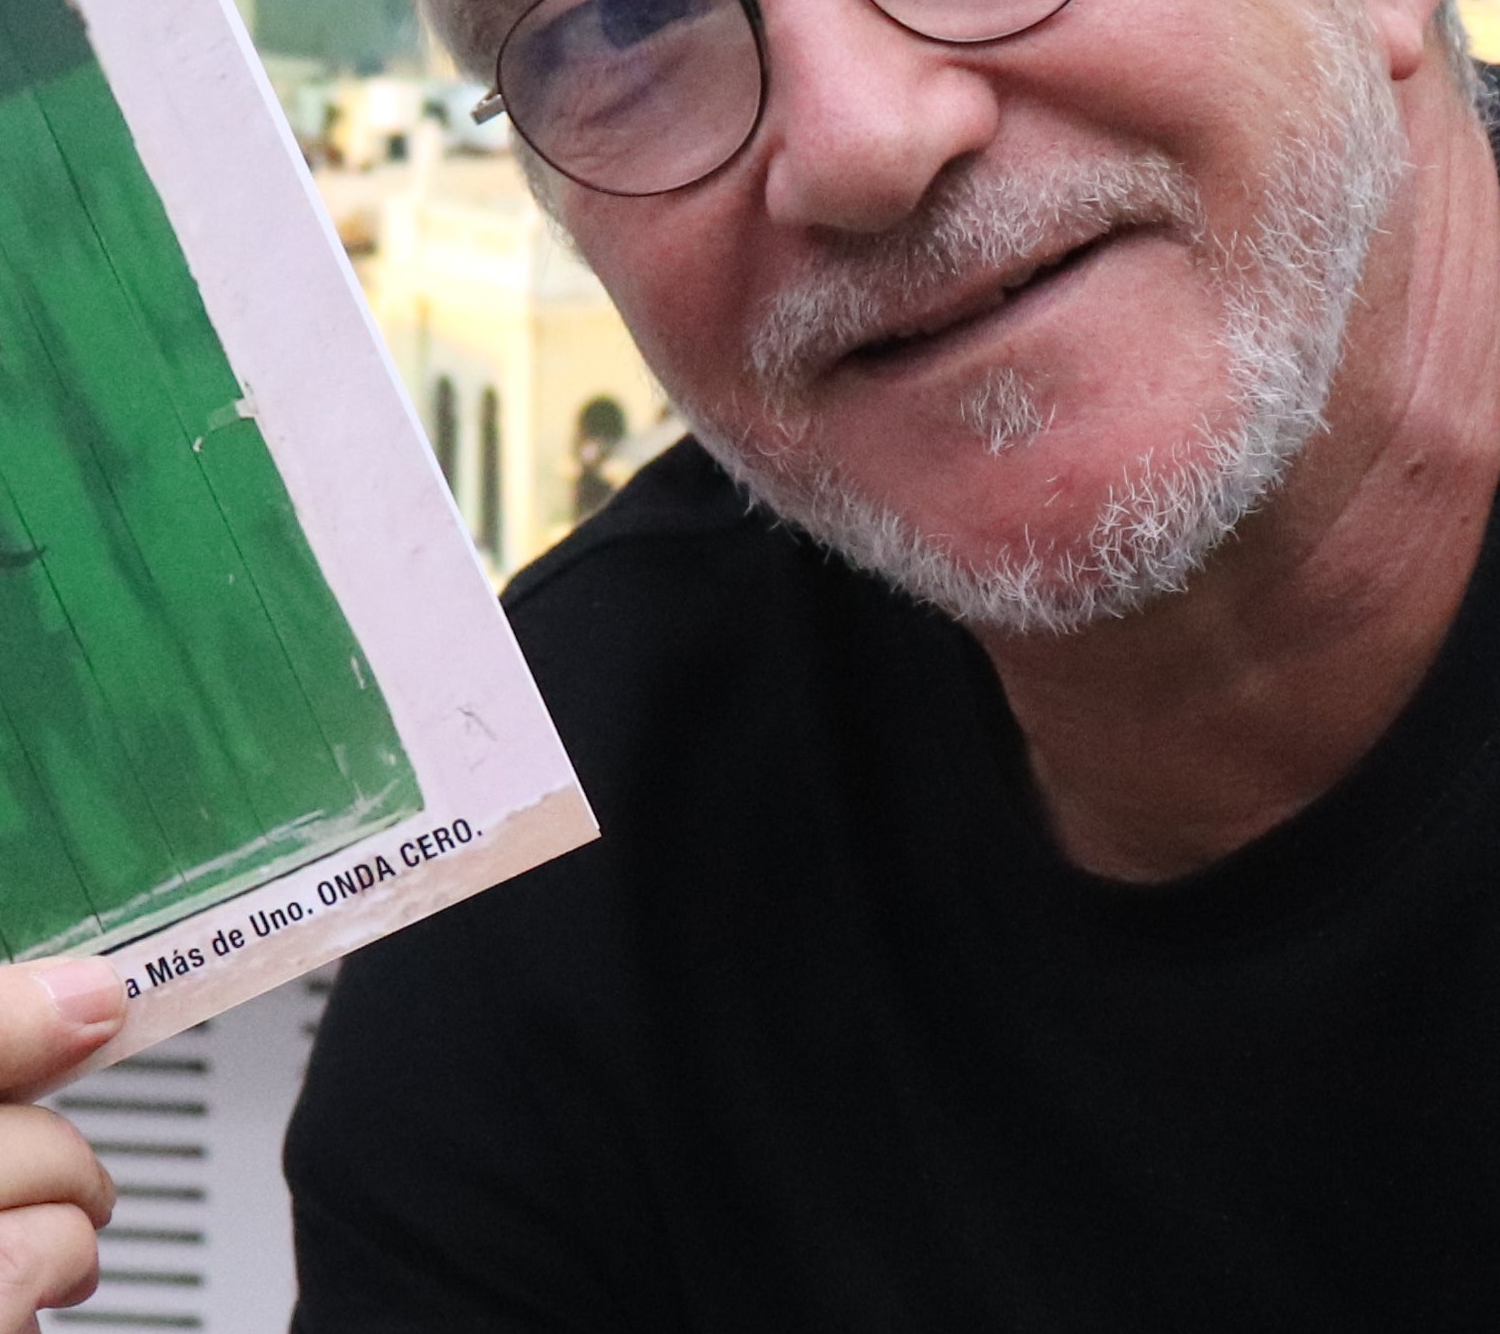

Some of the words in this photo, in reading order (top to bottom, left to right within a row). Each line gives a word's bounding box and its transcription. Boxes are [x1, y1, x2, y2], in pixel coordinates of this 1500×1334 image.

[144, 946, 205, 988] Más
[211, 928, 245, 956] de
[249, 900, 314, 938] Uno.
[316, 855, 395, 907] ONDA
[399, 817, 483, 867] CERO.
